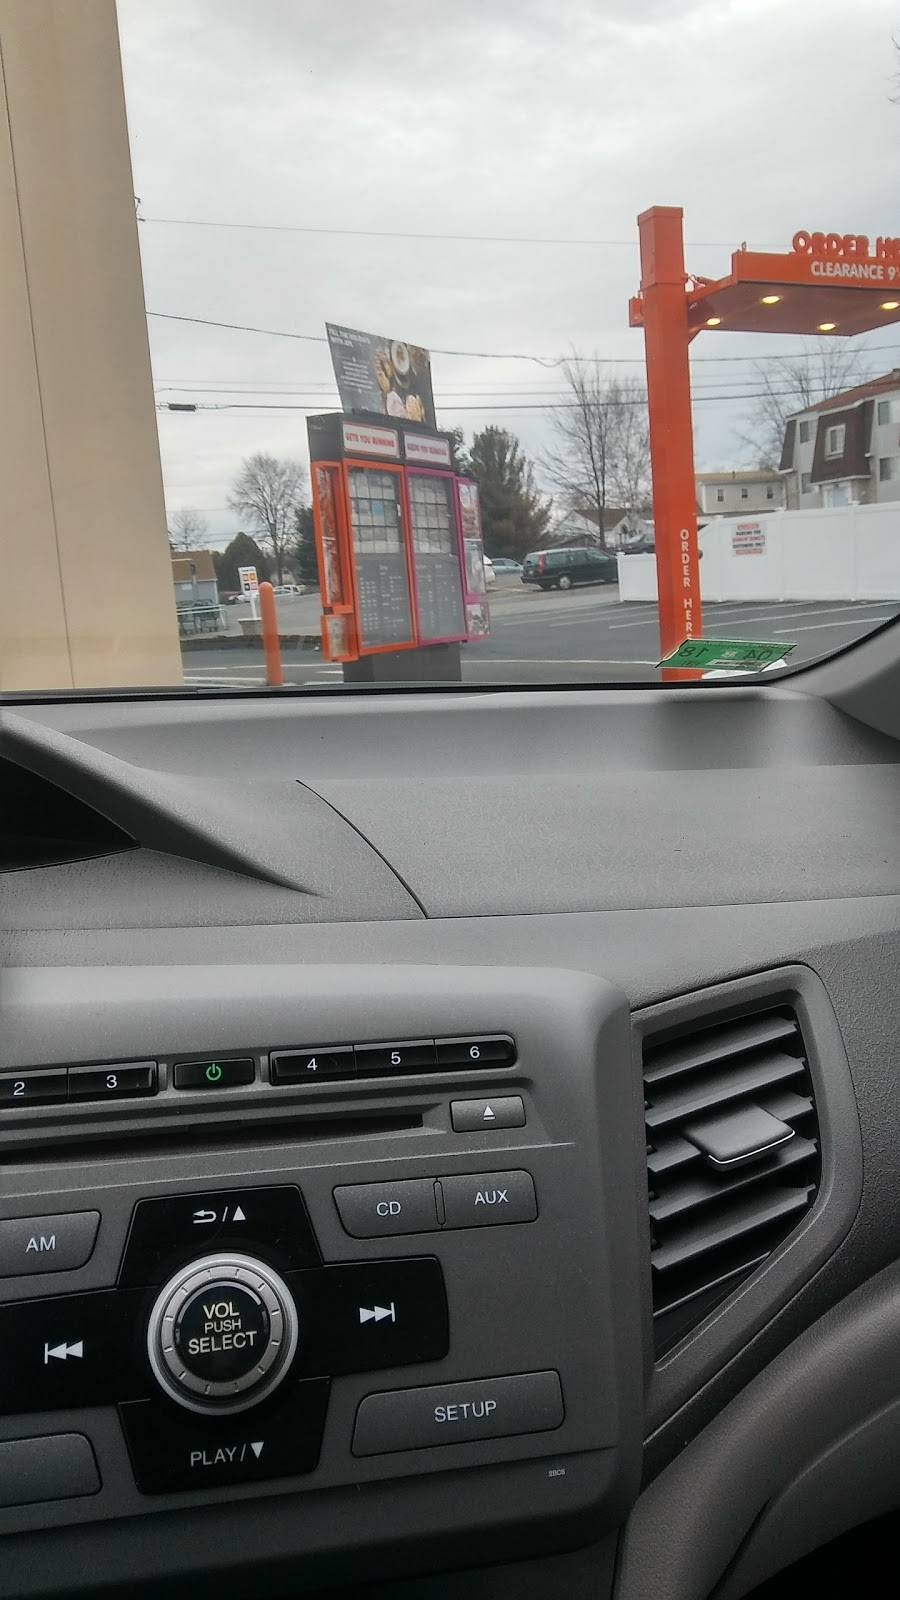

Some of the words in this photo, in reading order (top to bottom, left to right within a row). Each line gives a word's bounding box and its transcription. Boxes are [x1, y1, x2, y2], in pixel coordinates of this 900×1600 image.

[793, 230, 868, 256] ORDER
[811, 260, 884, 280] CLEARANCE
[680, 529, 690, 588] ORDER
[390, 1051, 401, 1065] 5
[469, 1046, 480, 1059] 6
[306, 1057, 318, 1071] 4
[13, 1081, 25, 1096] 2
[106, 1074, 117, 1089] 3
[474, 1189, 509, 1206] AUX
[376, 1201, 401, 1216] CD
[25, 1235, 56, 1253] AM
[203, 1301, 240, 1319] VOL
[204, 1318, 241, 1334] PUSH
[188, 1330, 258, 1355] SELECT
[434, 1400, 497, 1423] SETUP
